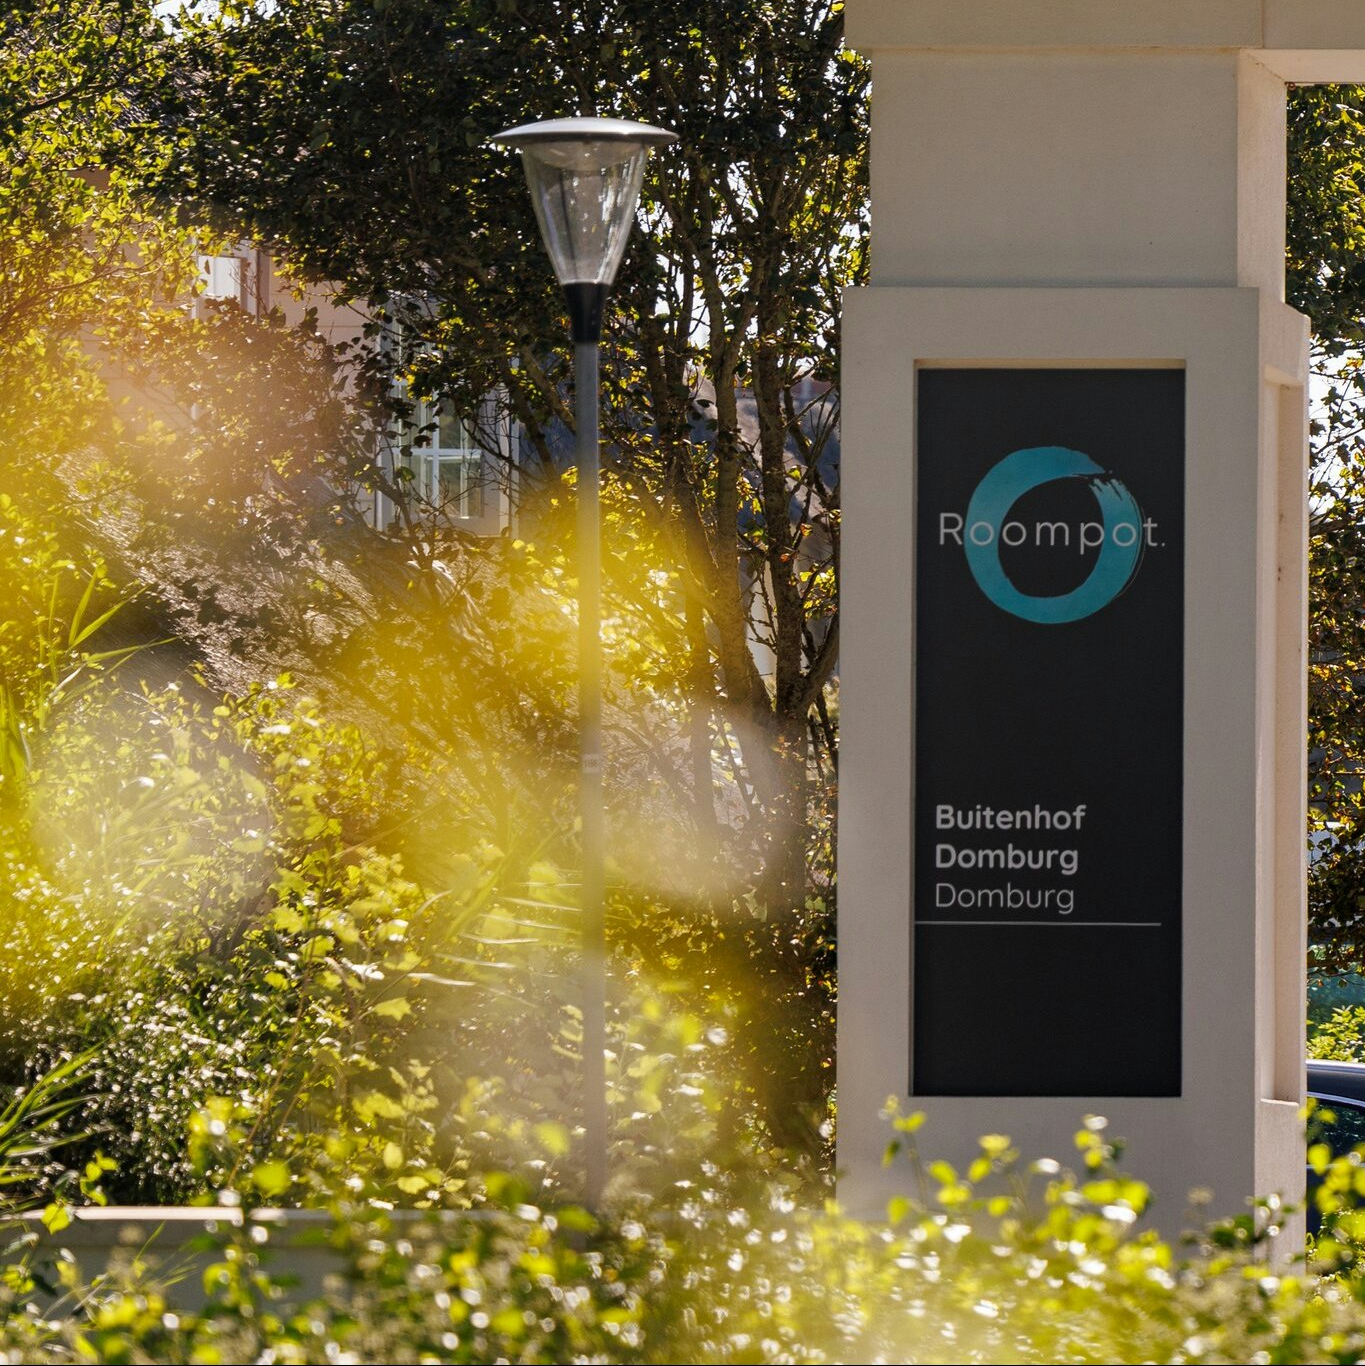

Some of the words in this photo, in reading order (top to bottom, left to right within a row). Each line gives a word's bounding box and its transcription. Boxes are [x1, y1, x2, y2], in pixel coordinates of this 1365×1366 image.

[935, 804, 1086, 830] Buitenhof
[935, 843, 1079, 875] Domburg
[935, 882, 1074, 914] Domburg
